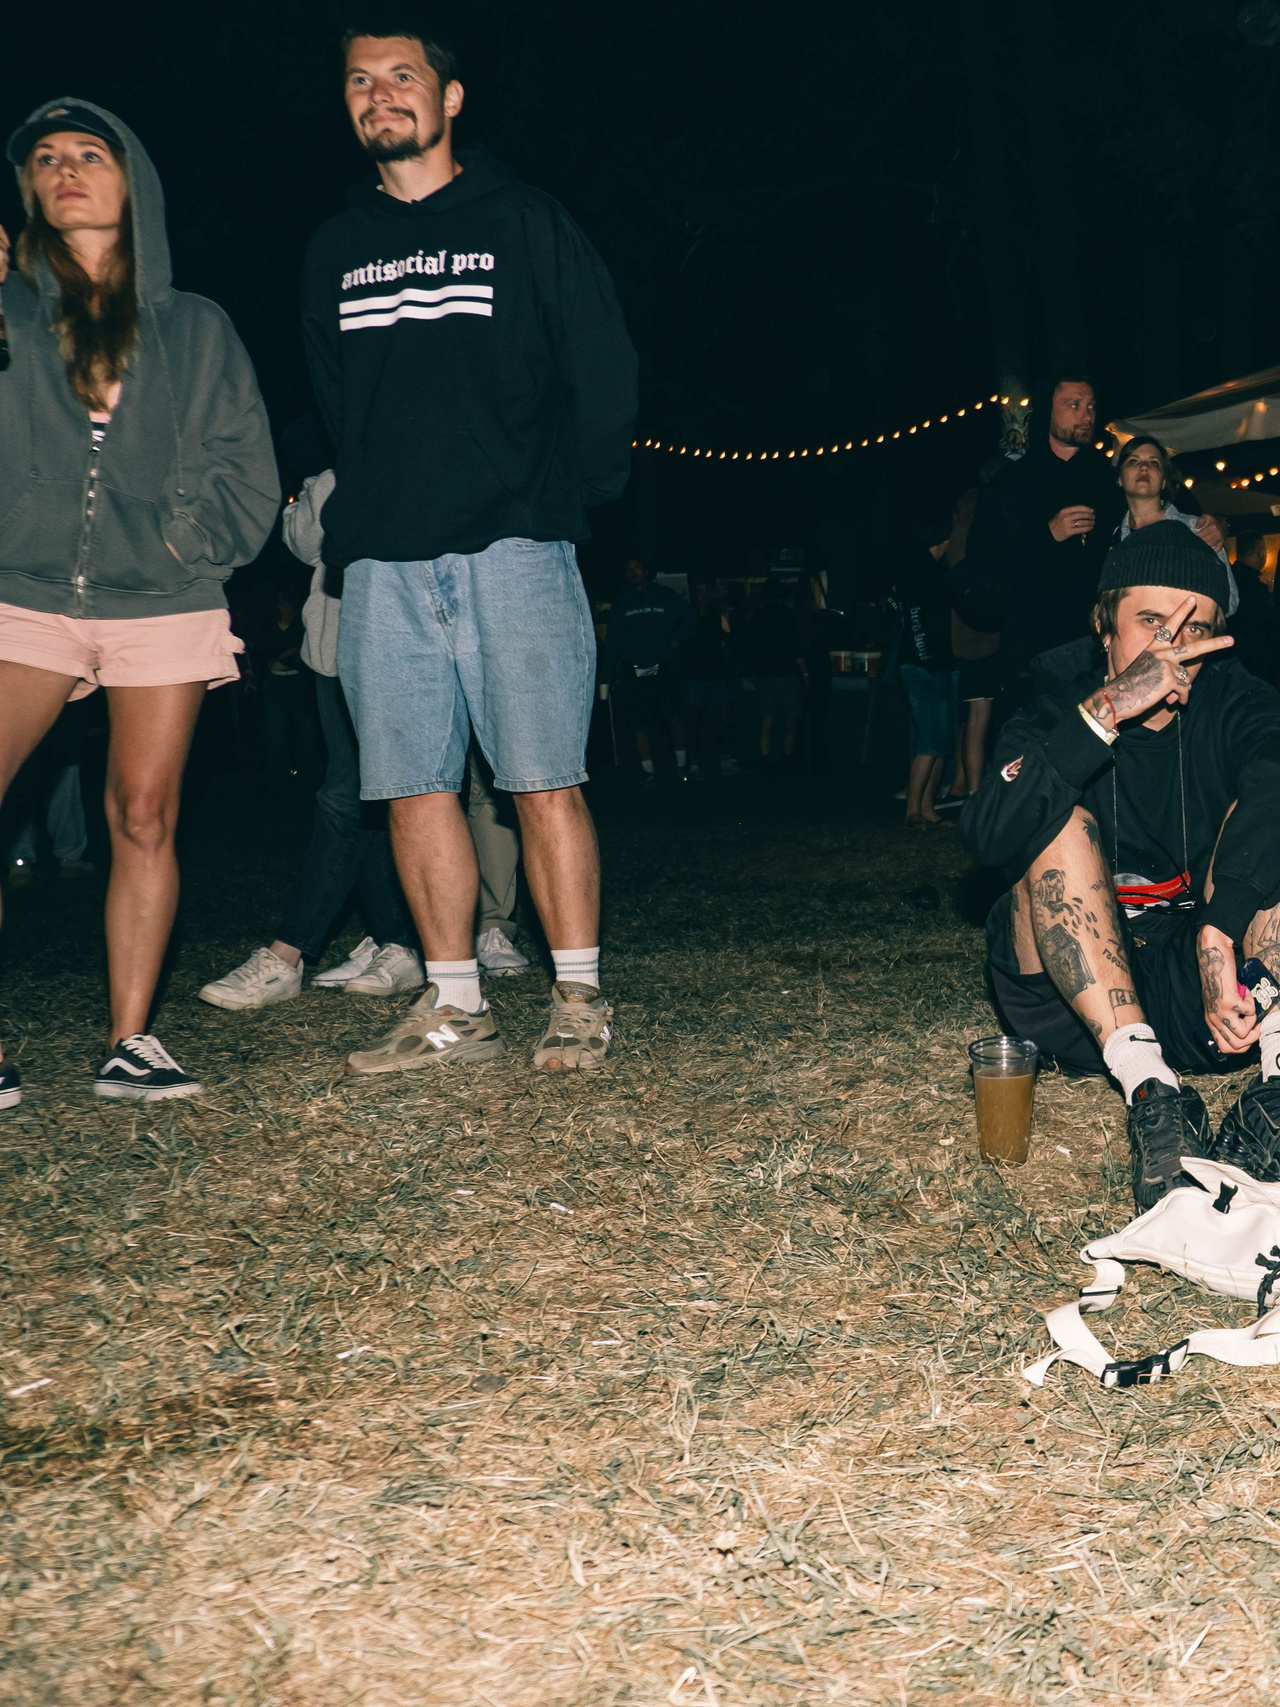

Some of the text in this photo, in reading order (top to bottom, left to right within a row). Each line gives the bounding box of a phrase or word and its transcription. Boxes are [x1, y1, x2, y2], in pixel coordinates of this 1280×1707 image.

[341, 250, 495, 291] antisocial pro
[425, 1023, 461, 1049] N
